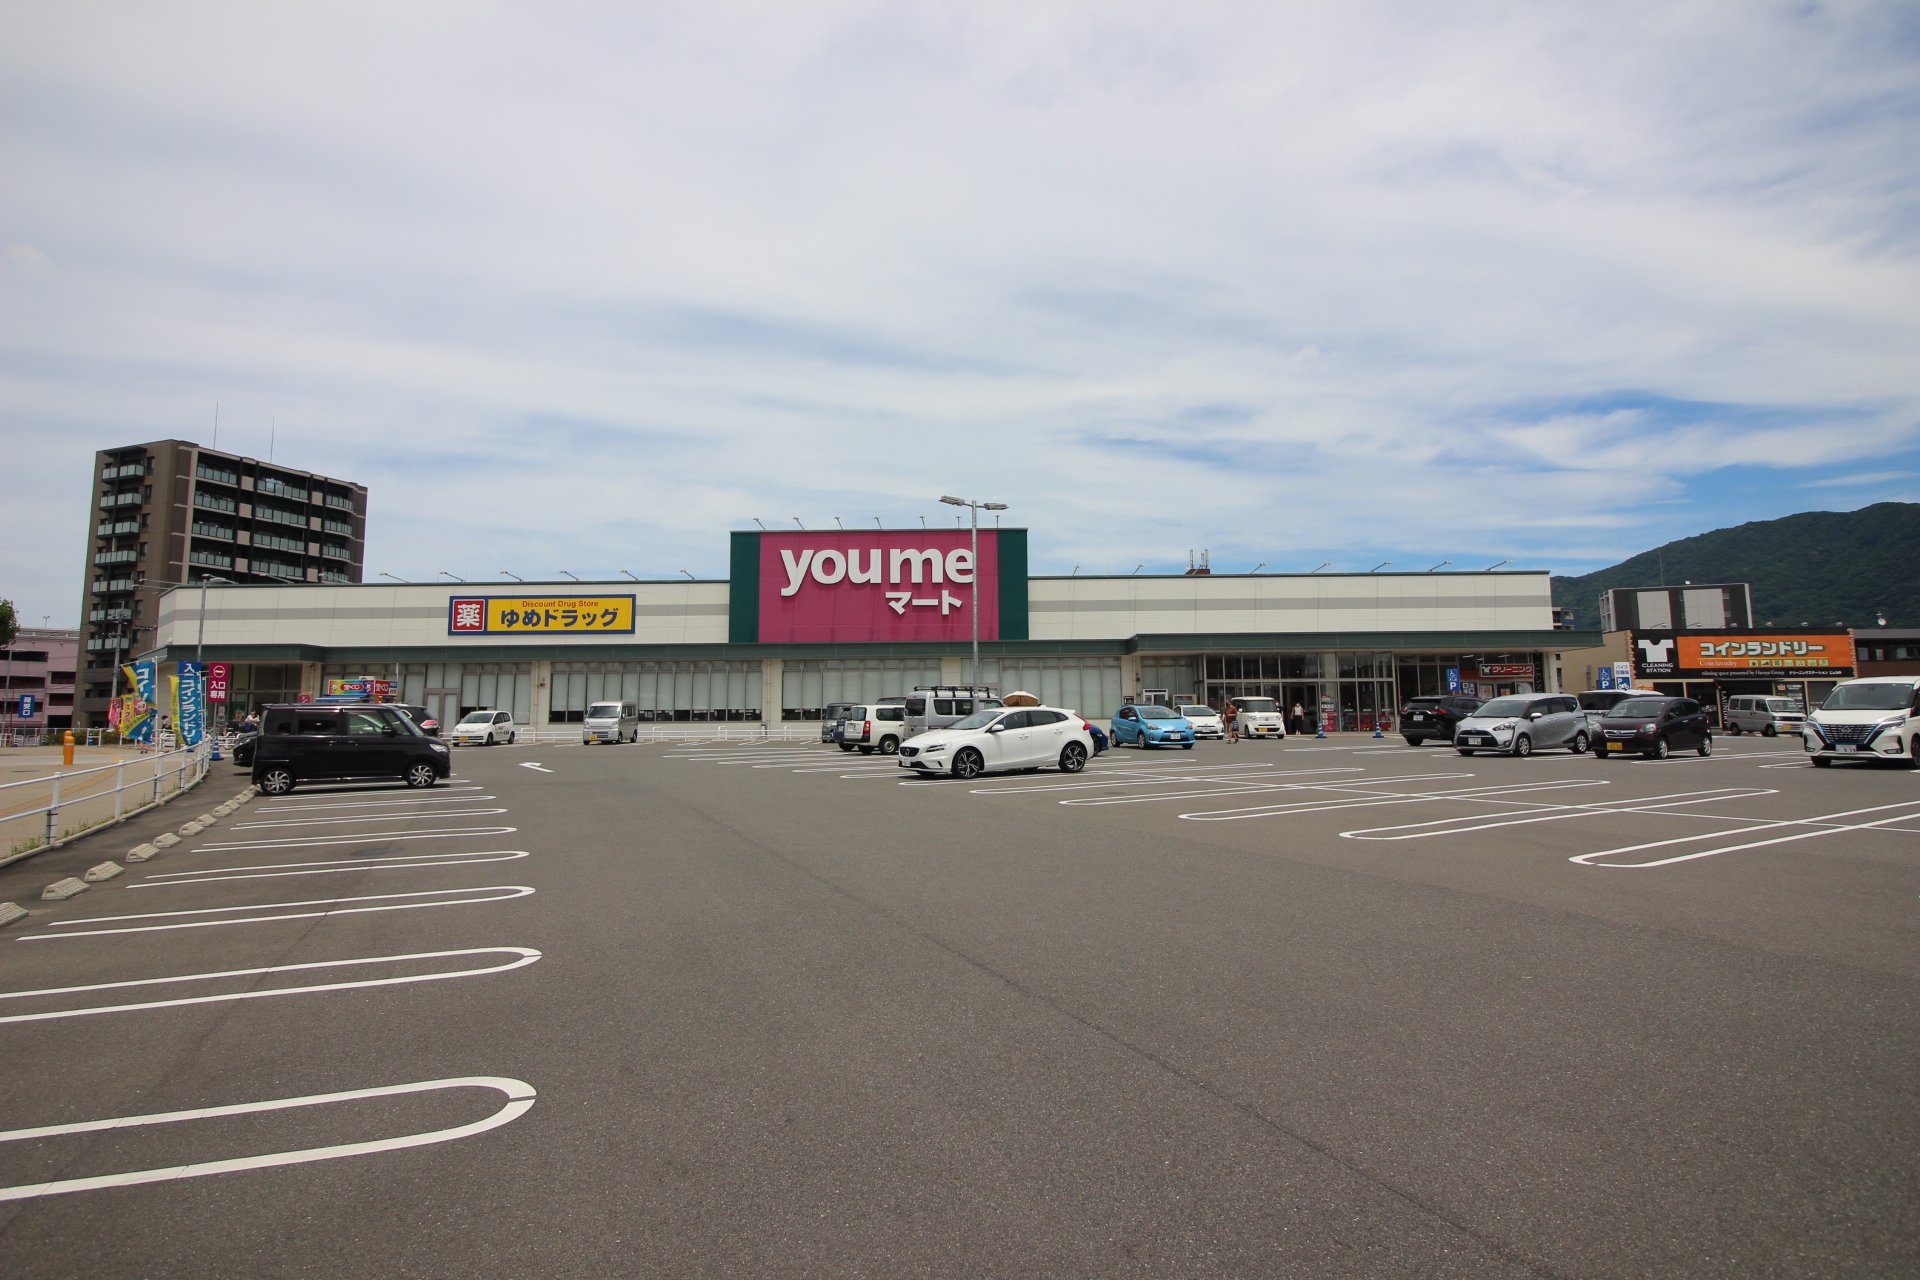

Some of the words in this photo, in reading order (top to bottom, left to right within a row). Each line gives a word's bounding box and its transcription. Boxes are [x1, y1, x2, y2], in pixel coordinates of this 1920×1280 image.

[780, 548, 974, 597] youme
[522, 600, 557, 608] Discount
[558, 600, 576, 608] Drug
[885, 589, 963, 615] マート
[456, 603, 481, 627] 薬
[500, 607, 619, 628] ゆめドラッグ
[1700, 640, 1825, 656] コインランドリー
[1491, 665, 1533, 673] クリーニング
[210, 681, 226, 690] 入口
[1602, 681, 1609, 689] P
[209, 690, 226, 699] 専用
[181, 679, 196, 745] コインランドリー
